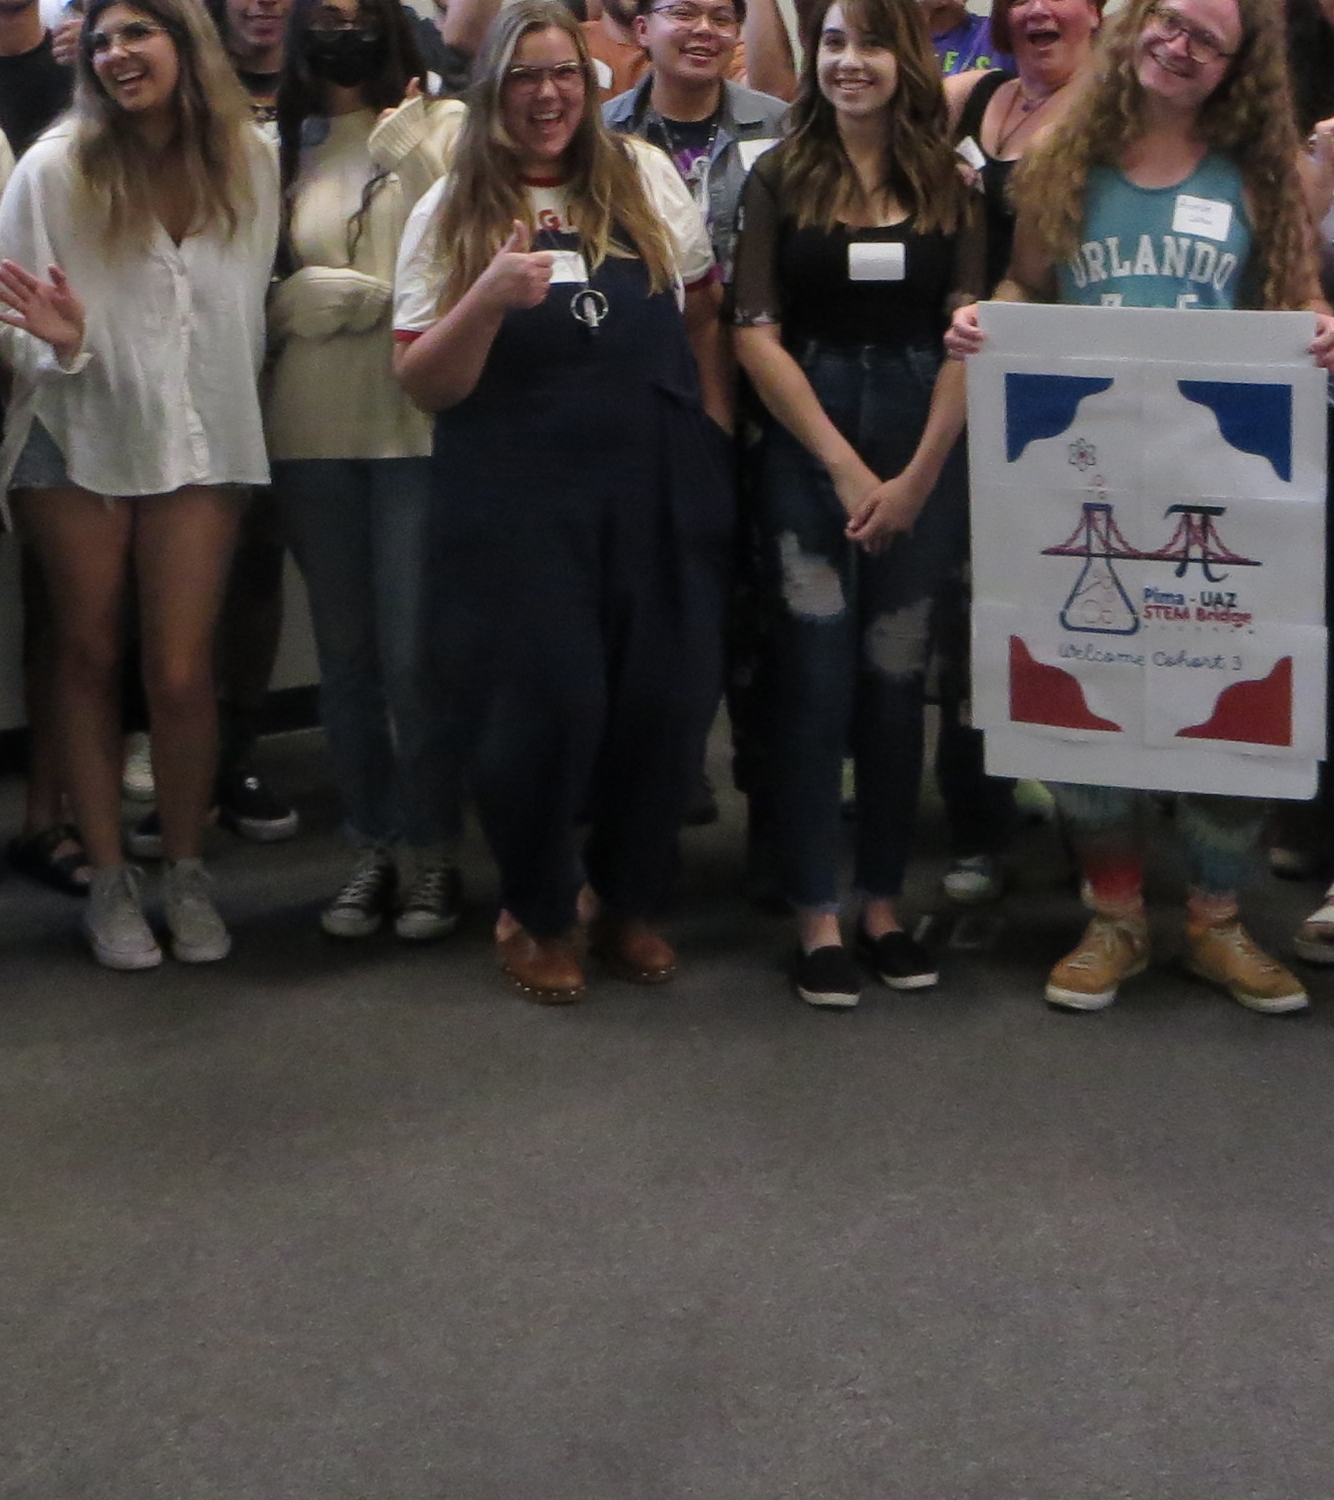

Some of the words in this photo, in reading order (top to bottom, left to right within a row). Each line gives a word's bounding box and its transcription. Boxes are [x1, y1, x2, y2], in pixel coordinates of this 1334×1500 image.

[1143, 586, 1185, 605] Pima
[1200, 590, 1238, 608] UAZ
[1195, 607, 1253, 628] Bridge
[1060, 643, 1146, 667] Welcome
[1152, 650, 1226, 670] Cohort
